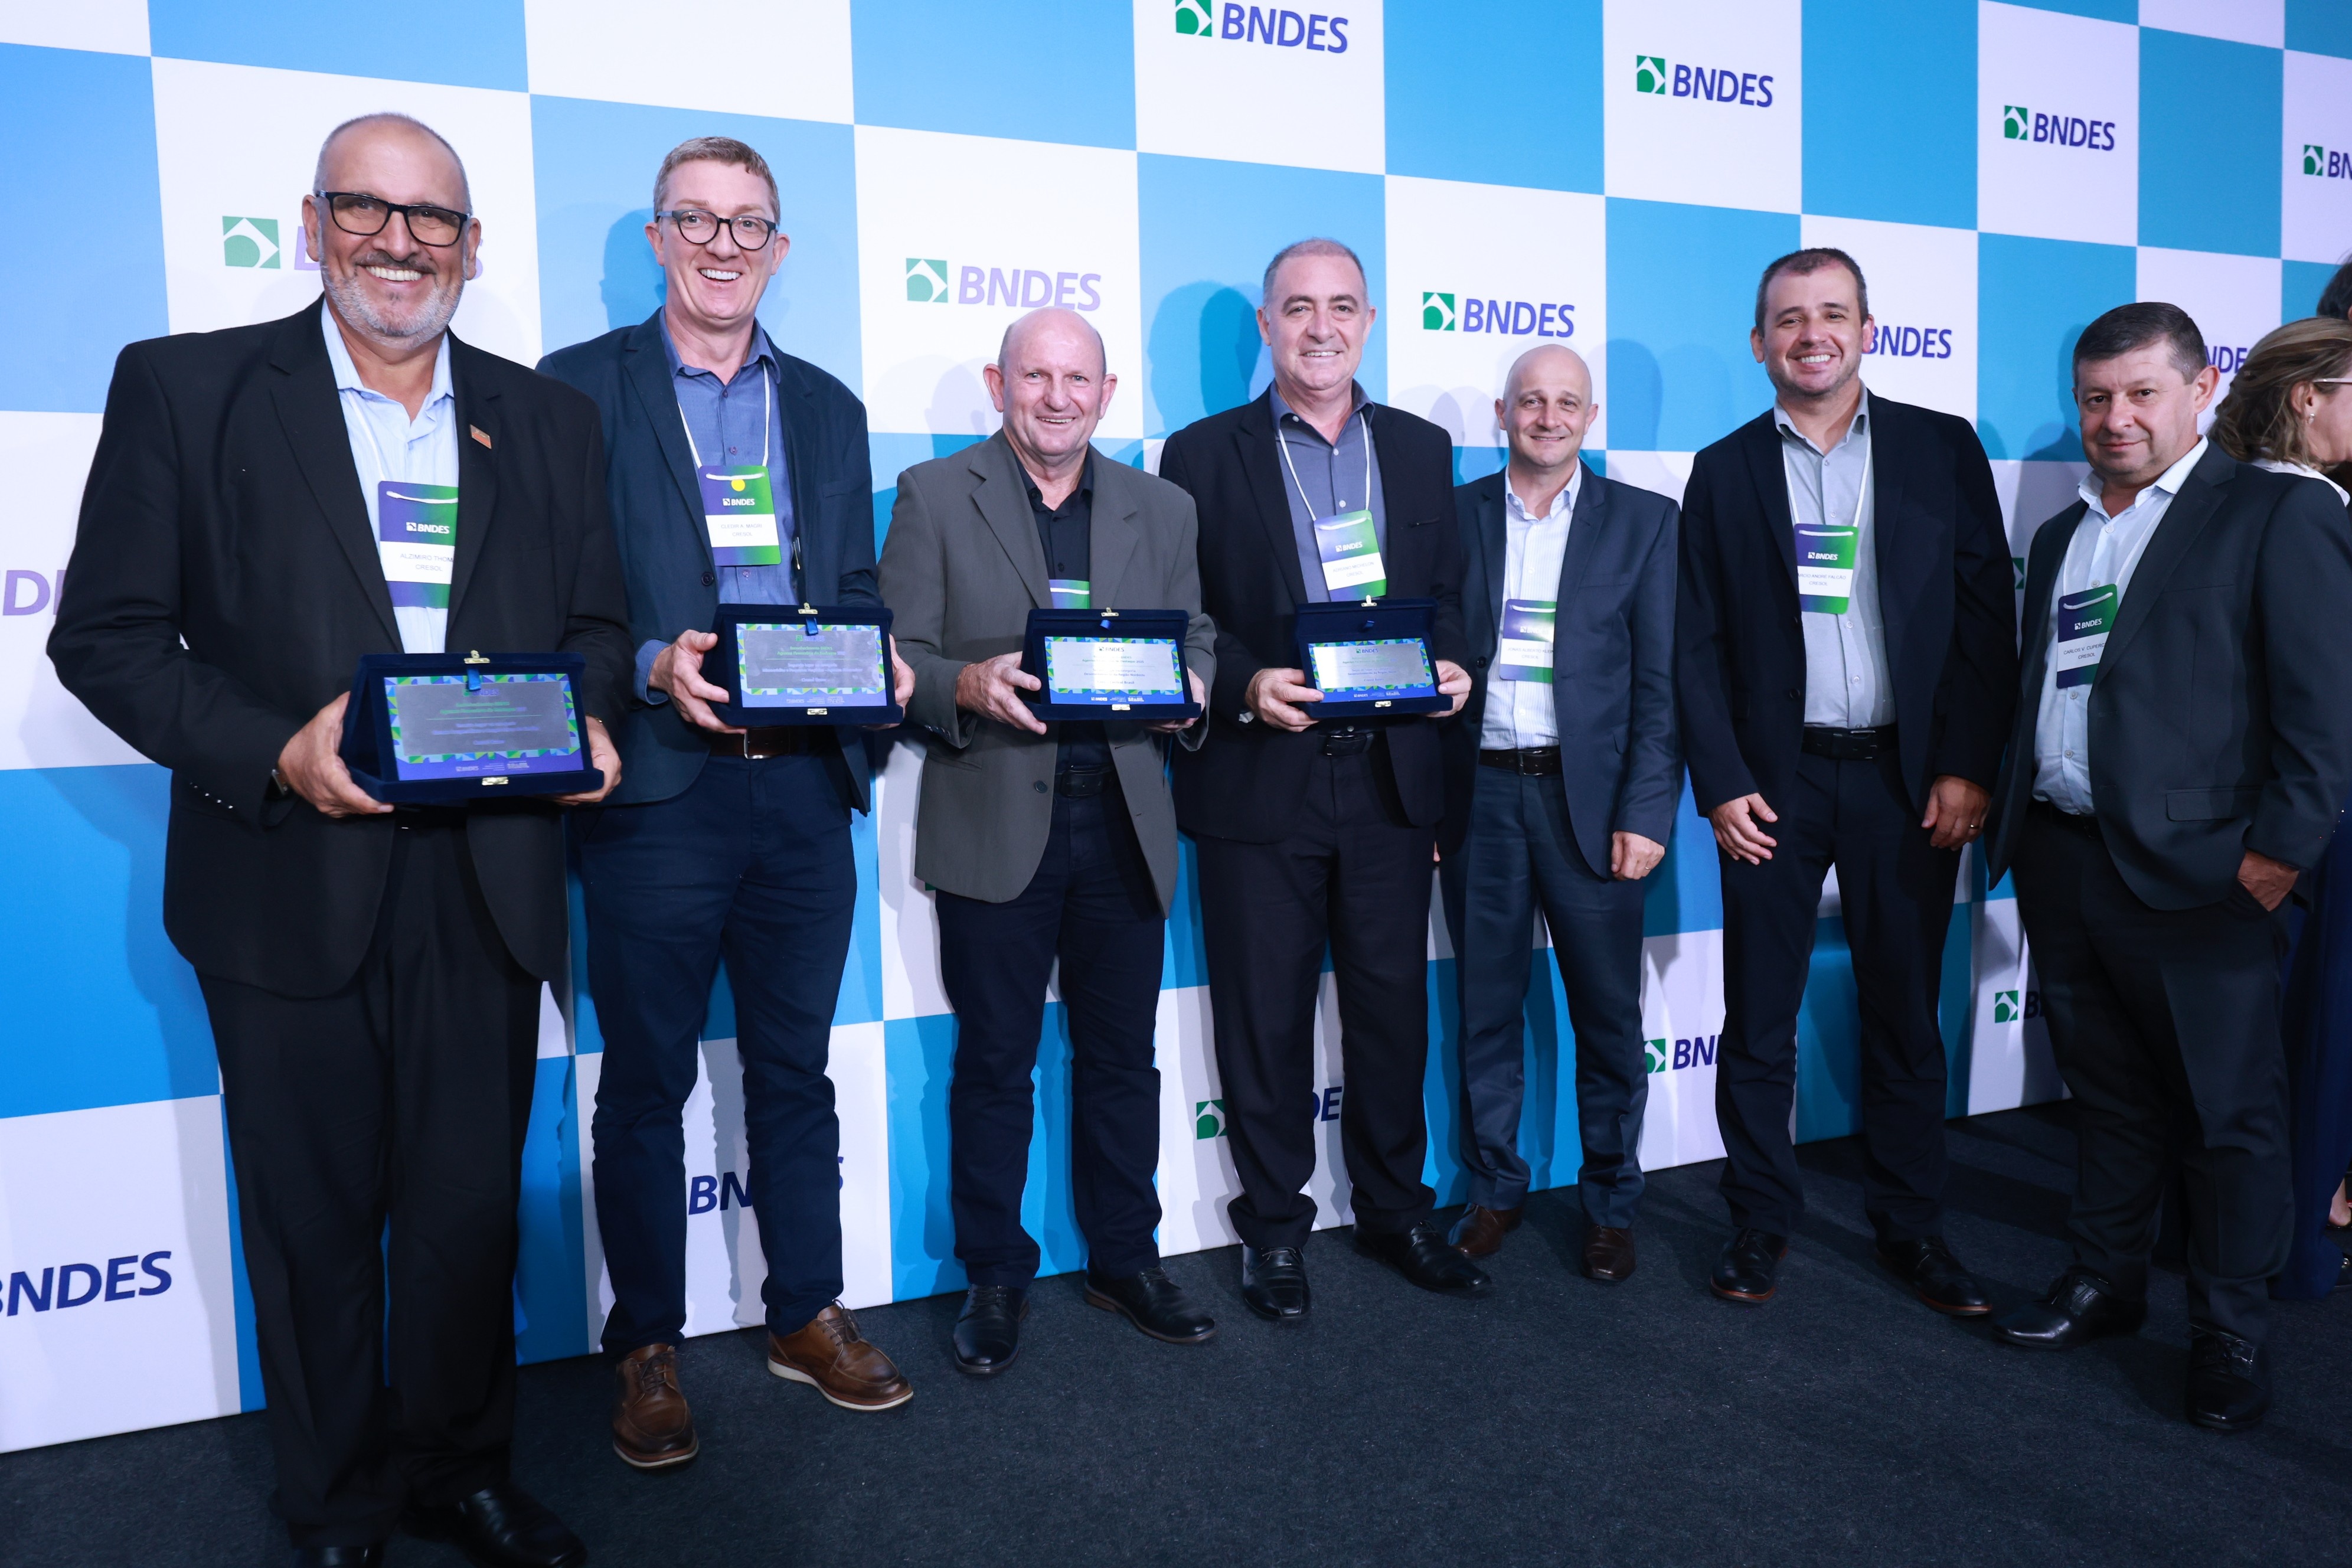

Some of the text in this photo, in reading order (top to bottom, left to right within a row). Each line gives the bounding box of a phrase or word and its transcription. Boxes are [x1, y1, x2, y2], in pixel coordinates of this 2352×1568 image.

[1221, 2, 1348, 54] BNDES
[1673, 64, 1773, 107] BNDES
[2033, 112, 2115, 151] BNDES
[958, 266, 1102, 312] BNDES
[1463, 298, 1575, 338] BNDES
[417, 522, 450, 534] BNDES
[1342, 542, 1363, 551] BNDES
[400, 553, 432, 561] ALZIMIRO
[2082, 619, 2102, 629] BNDES
[2063, 647, 2080, 655] CARLOS
[0, 1250, 172, 1317] NDES
